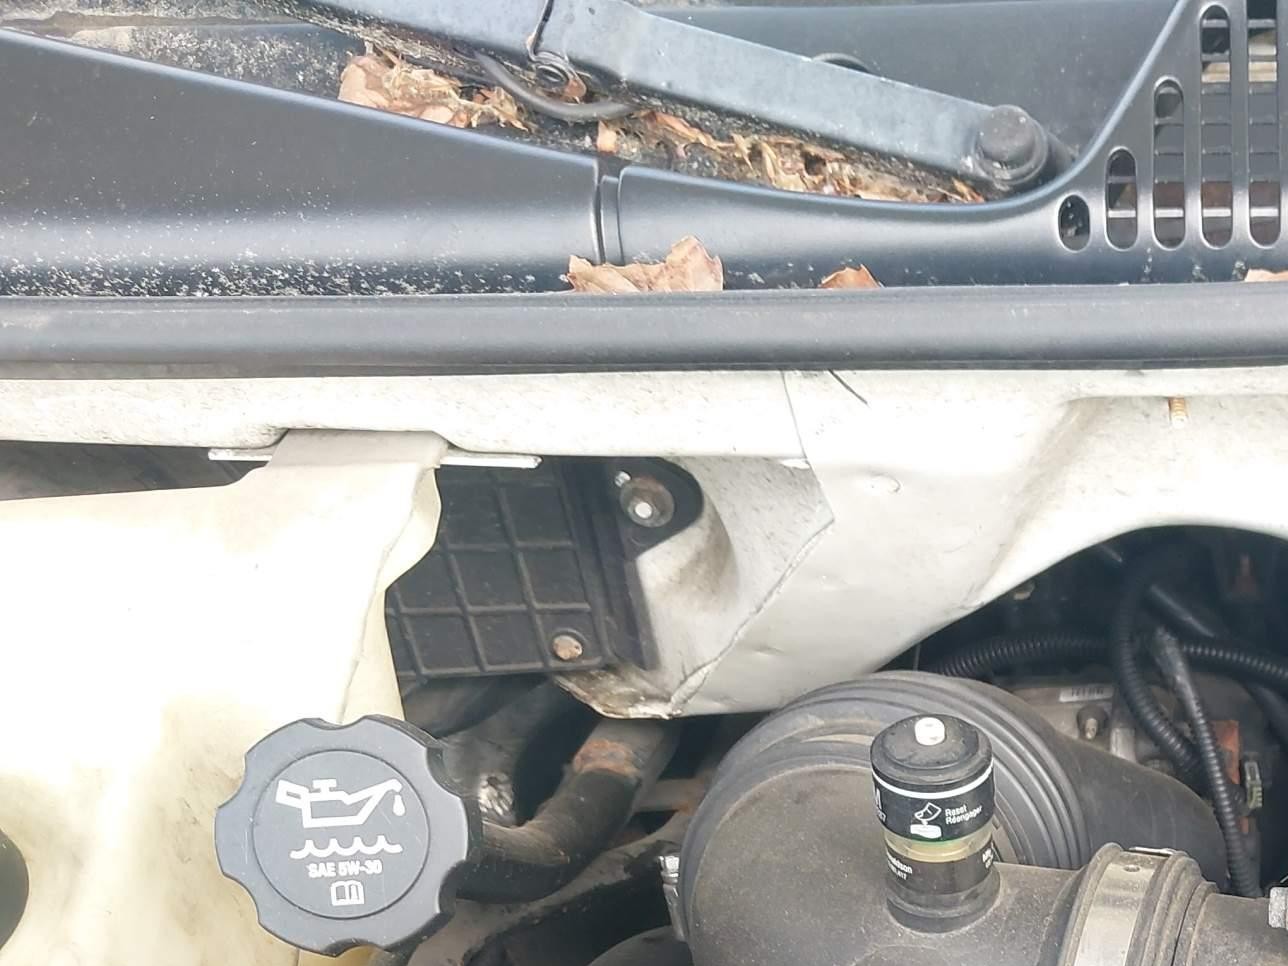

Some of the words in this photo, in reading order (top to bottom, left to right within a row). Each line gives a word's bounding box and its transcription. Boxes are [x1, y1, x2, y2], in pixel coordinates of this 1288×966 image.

[945, 804, 967, 816] Reset
[307, 861, 337, 878] SAE
[338, 859, 383, 876] 5W-30
